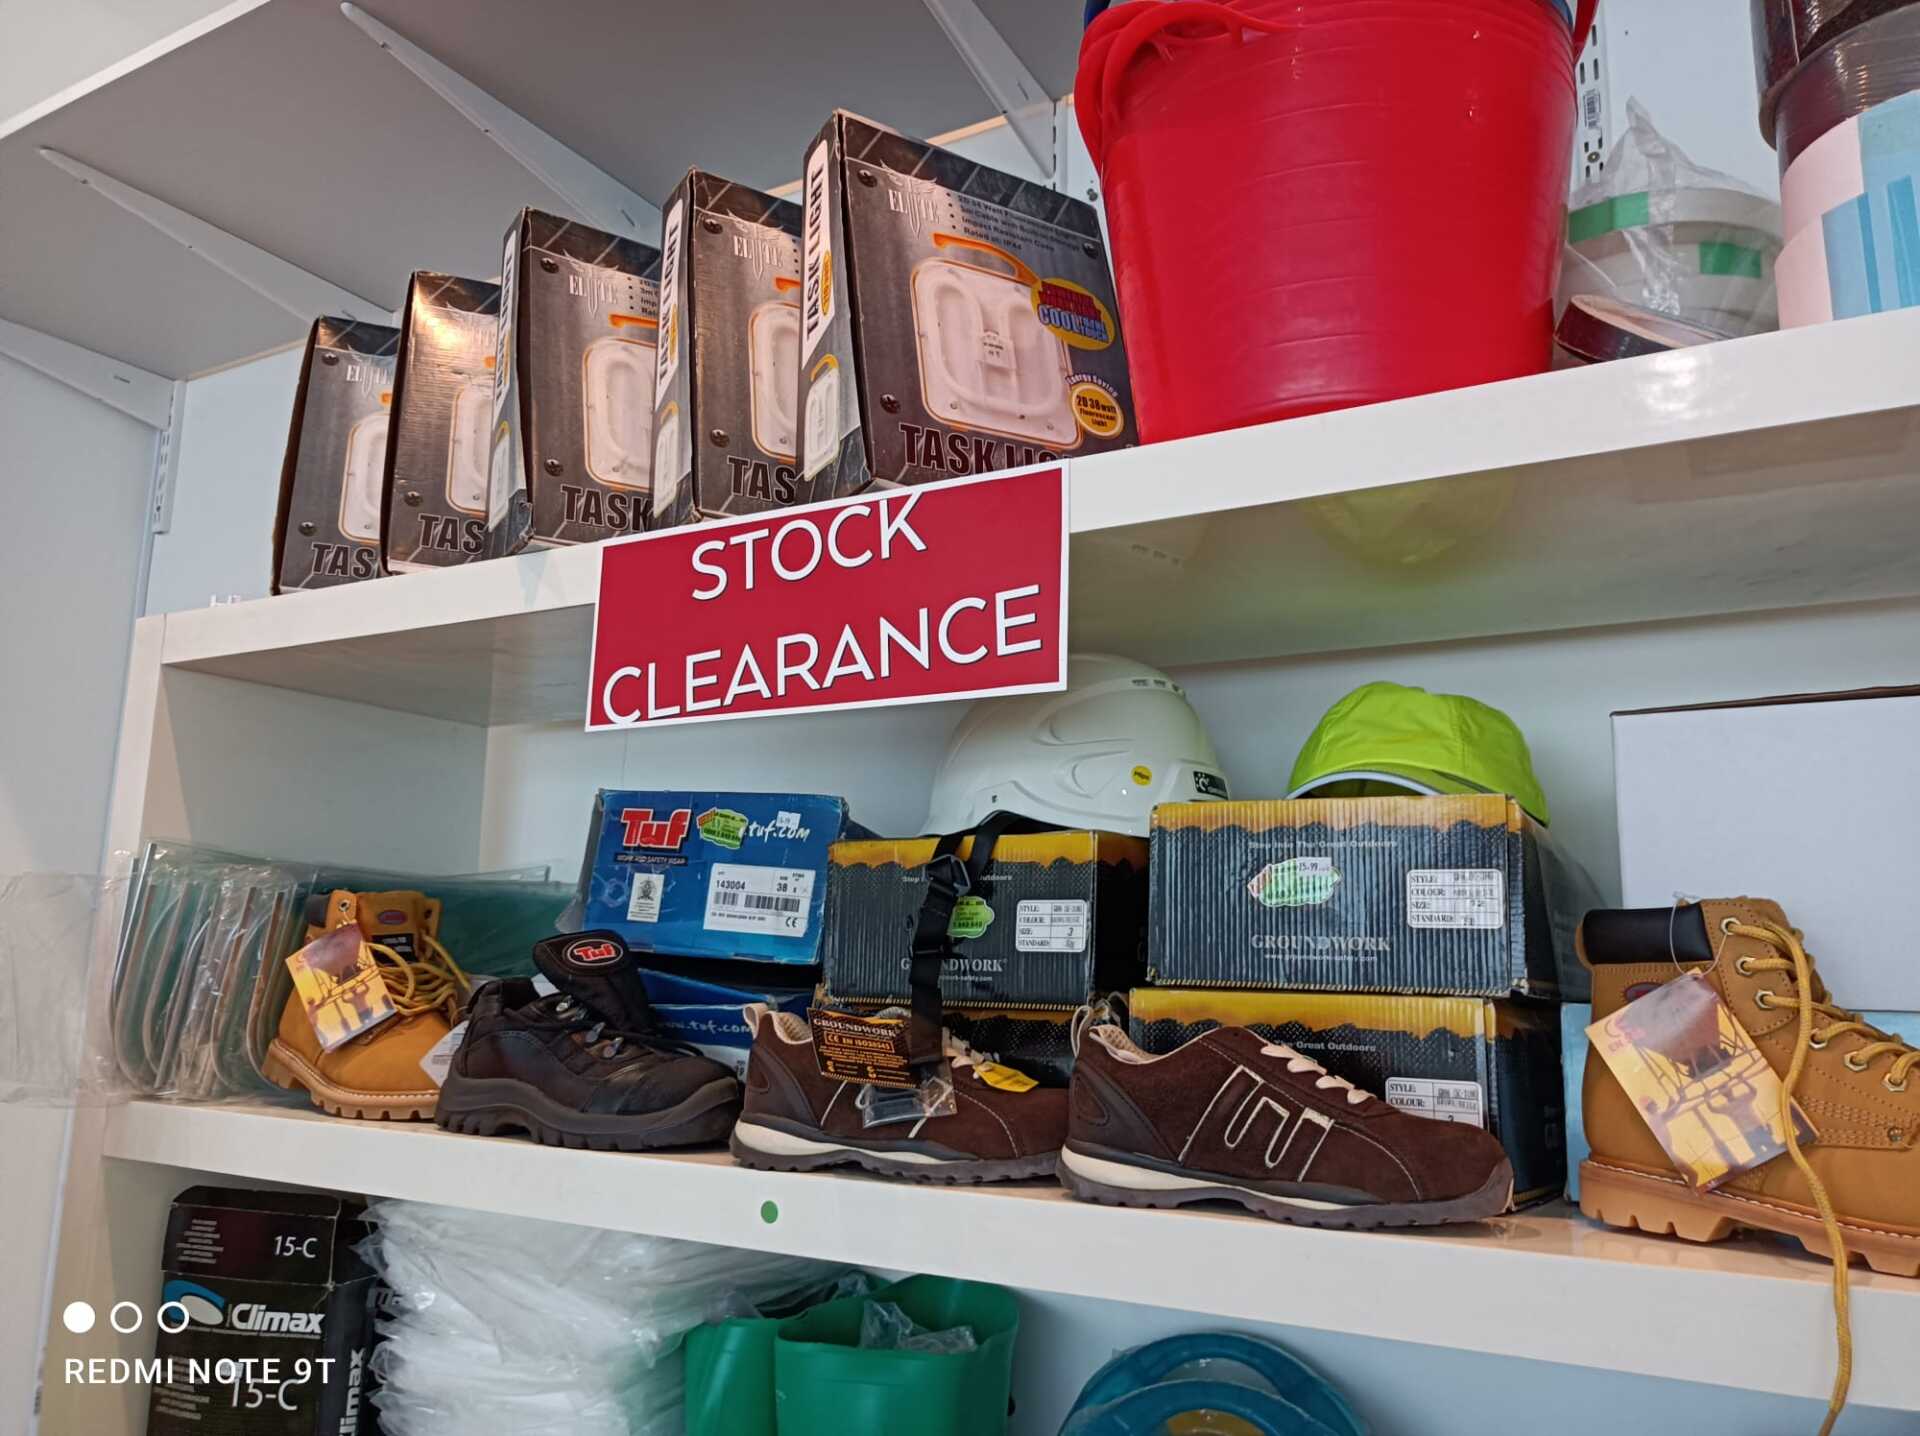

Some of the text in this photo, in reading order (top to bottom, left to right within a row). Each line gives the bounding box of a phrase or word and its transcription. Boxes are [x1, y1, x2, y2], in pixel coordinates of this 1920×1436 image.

[806, 256, 821, 341] TASK
[899, 422, 997, 475] TASK
[727, 455, 797, 505] TAS
[418, 513, 485, 554] TAS
[691, 491, 928, 600] STOCK
[312, 542, 379, 579] TAS
[603, 584, 1043, 725] CLEARANCE
[621, 807, 692, 849] Tuf
[716, 880, 746, 890] 143004
[776, 882, 788, 892] 38
[573, 943, 616, 961] Tuf
[1252, 934, 1391, 951] GROUNDWORK
[813, 1018, 897, 1037] GROUNDWORK
[1296, 1041, 1326, 1050] Great
[1327, 1042, 1377, 1052] Outdoors
[274, 1235, 318, 1258] 15-C
[231, 1303, 326, 1334] Climax
[338, 1348, 365, 1436] limax
